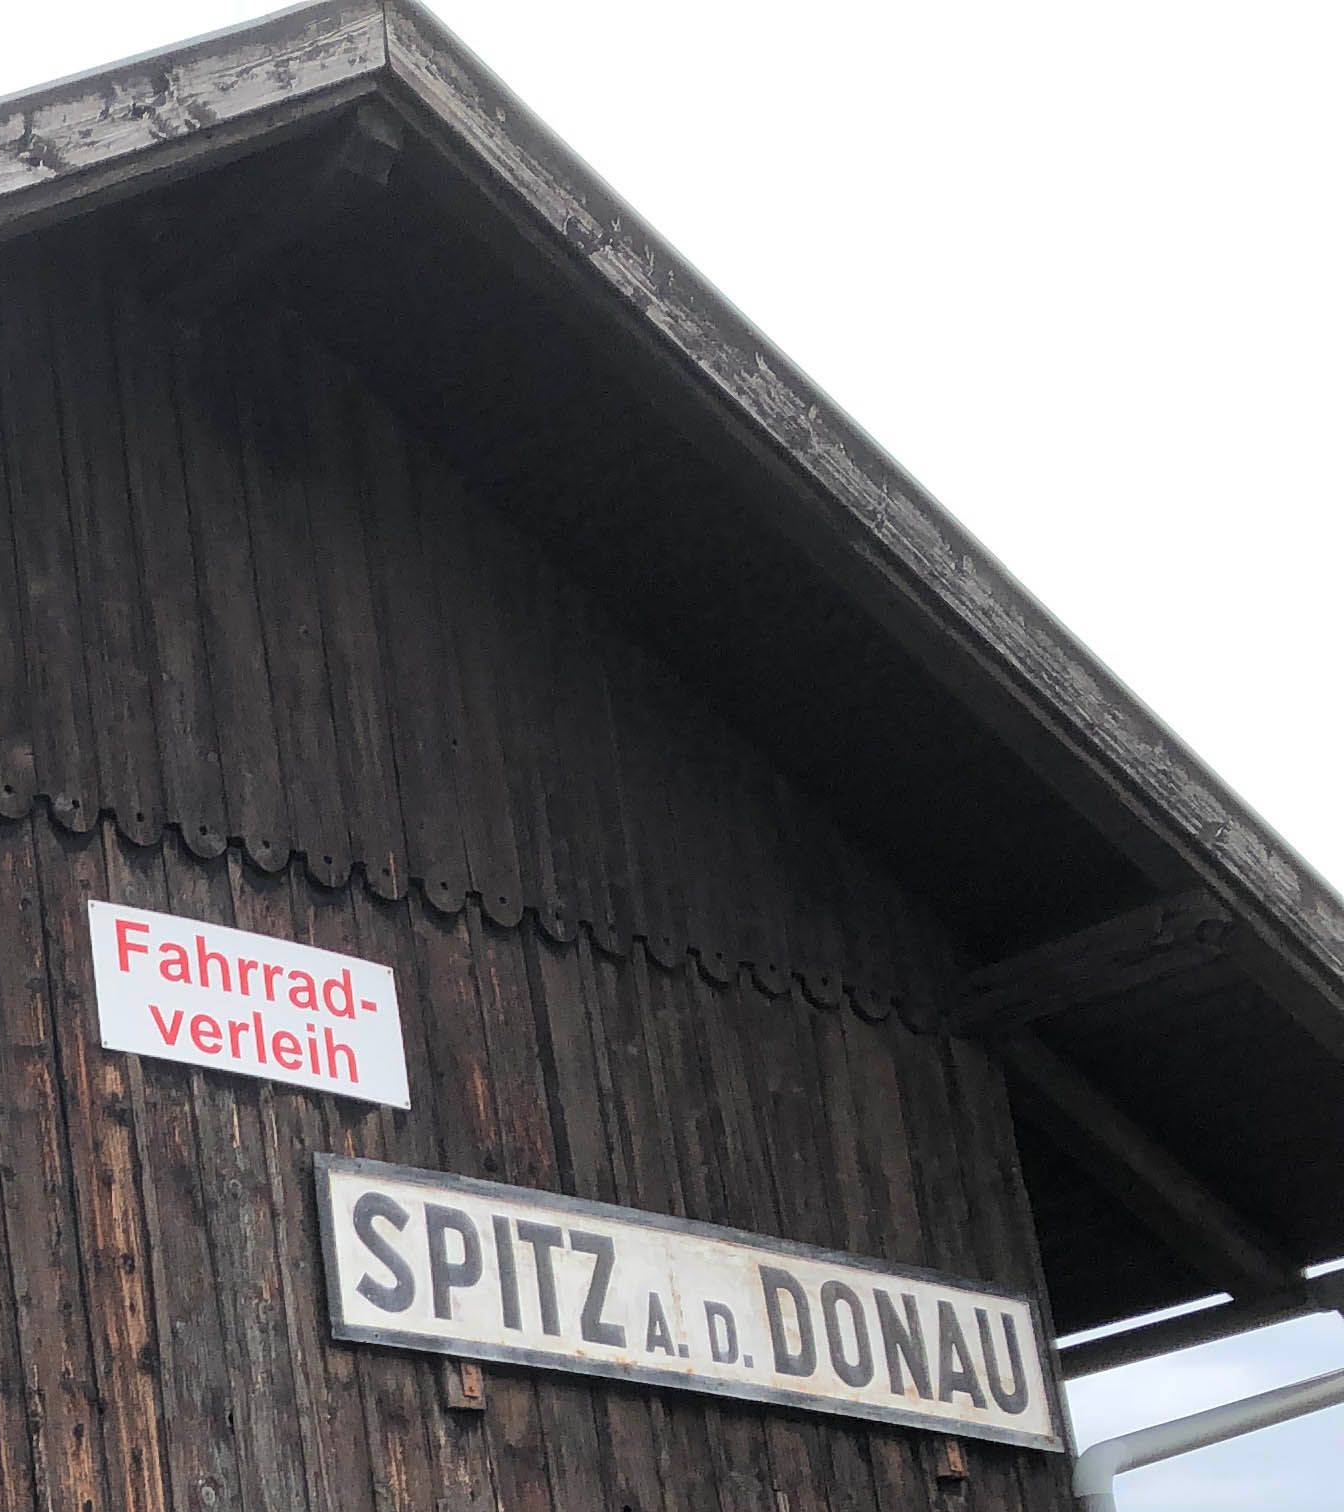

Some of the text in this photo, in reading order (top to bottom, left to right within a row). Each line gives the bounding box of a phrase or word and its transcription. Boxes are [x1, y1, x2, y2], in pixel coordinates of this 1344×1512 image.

[113, 917, 379, 1020] Fahrrad-
[148, 1003, 359, 1083] verleih
[351, 1190, 627, 1348] SPITZ
[757, 1263, 1026, 1416] DONAU
